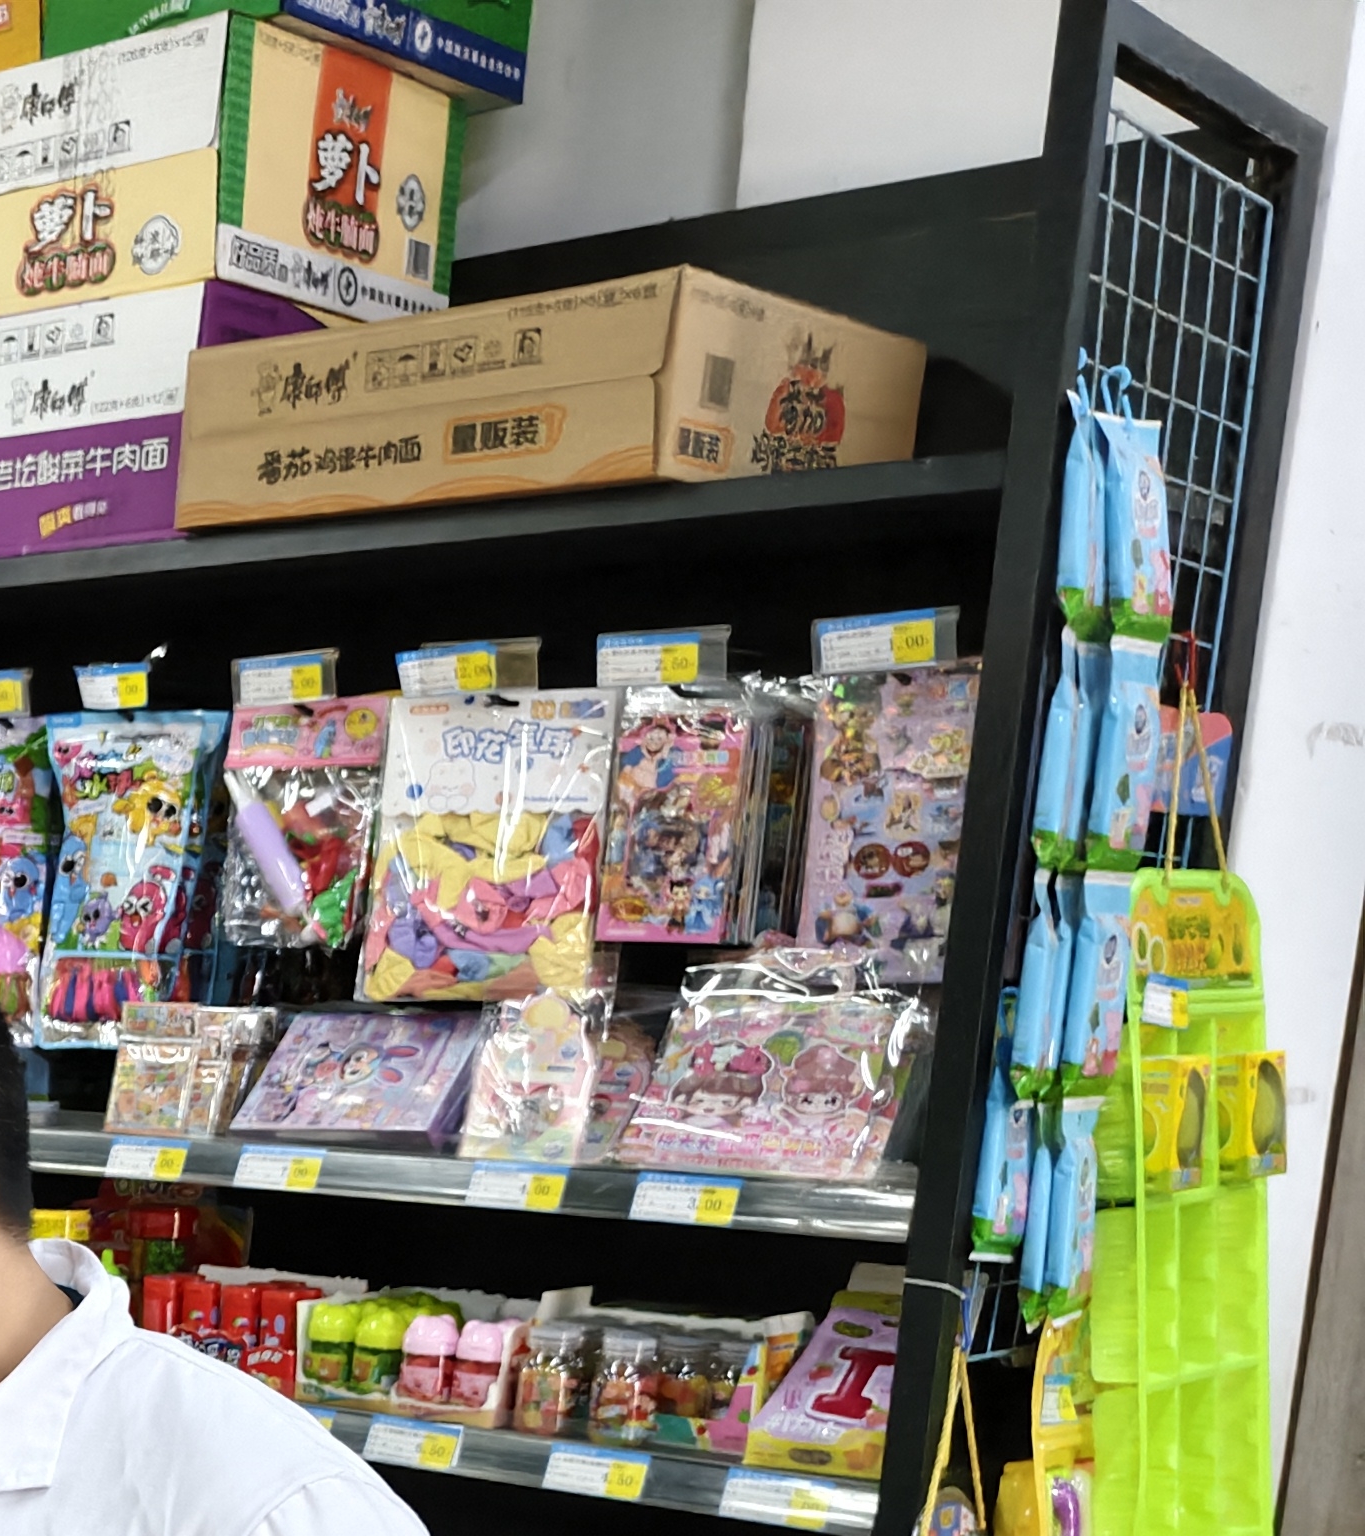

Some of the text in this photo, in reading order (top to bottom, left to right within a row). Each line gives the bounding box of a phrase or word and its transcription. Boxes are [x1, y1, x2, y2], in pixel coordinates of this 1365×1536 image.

[312, 132, 380, 205] 萝卜
[26, 188, 114, 255] 萝卜
[256, 434, 423, 487] 番茄鸡蛋牛肉面
[450, 414, 542, 456] 量贩装
